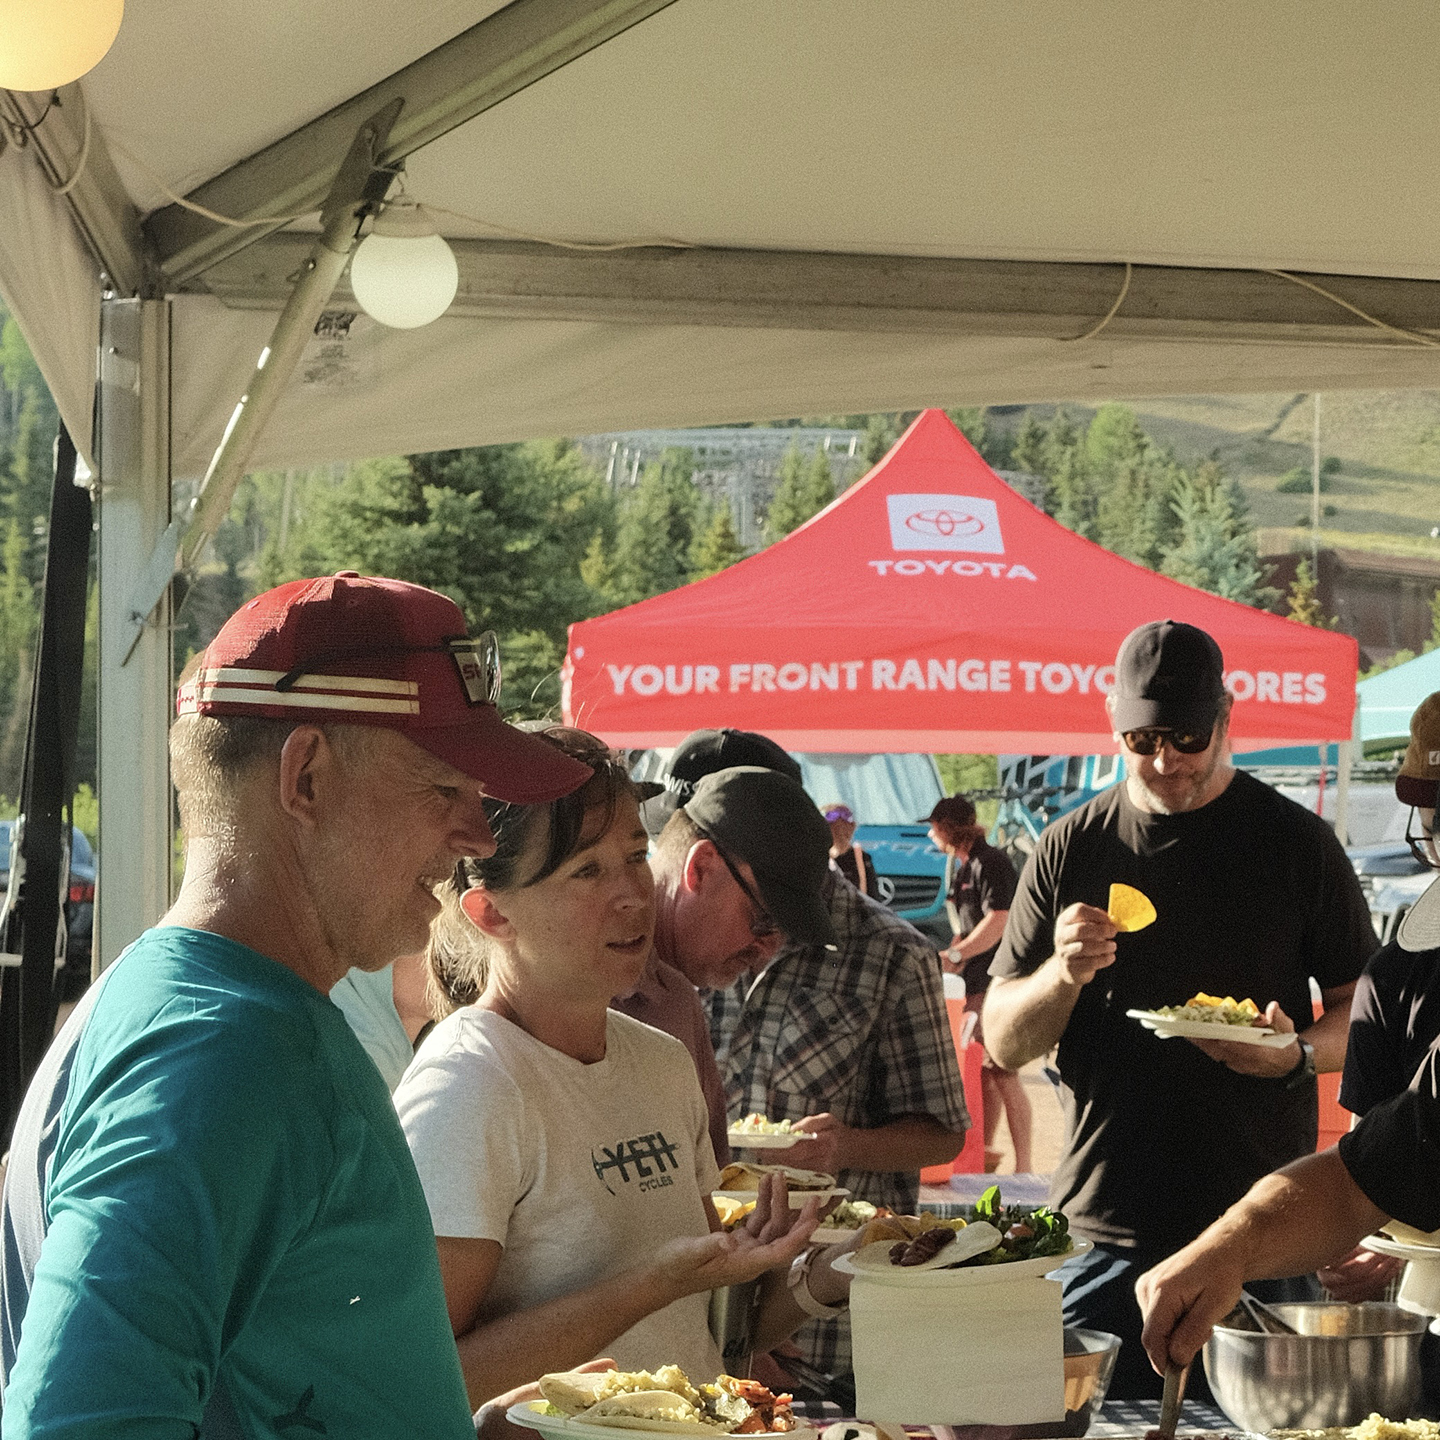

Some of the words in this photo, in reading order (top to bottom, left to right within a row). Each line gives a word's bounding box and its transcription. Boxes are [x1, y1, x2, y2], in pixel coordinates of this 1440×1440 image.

[868, 559, 1039, 582] TOYOTA
[607, 663, 720, 696] YOUR
[729, 661, 863, 694] FRONT
[871, 658, 1012, 693] RANGE
[1018, 661, 1116, 695] TOYO
[1222, 670, 1327, 705] ORES
[602, 1131, 679, 1183] YETI
[639, 1175, 674, 1193] CYCLES
